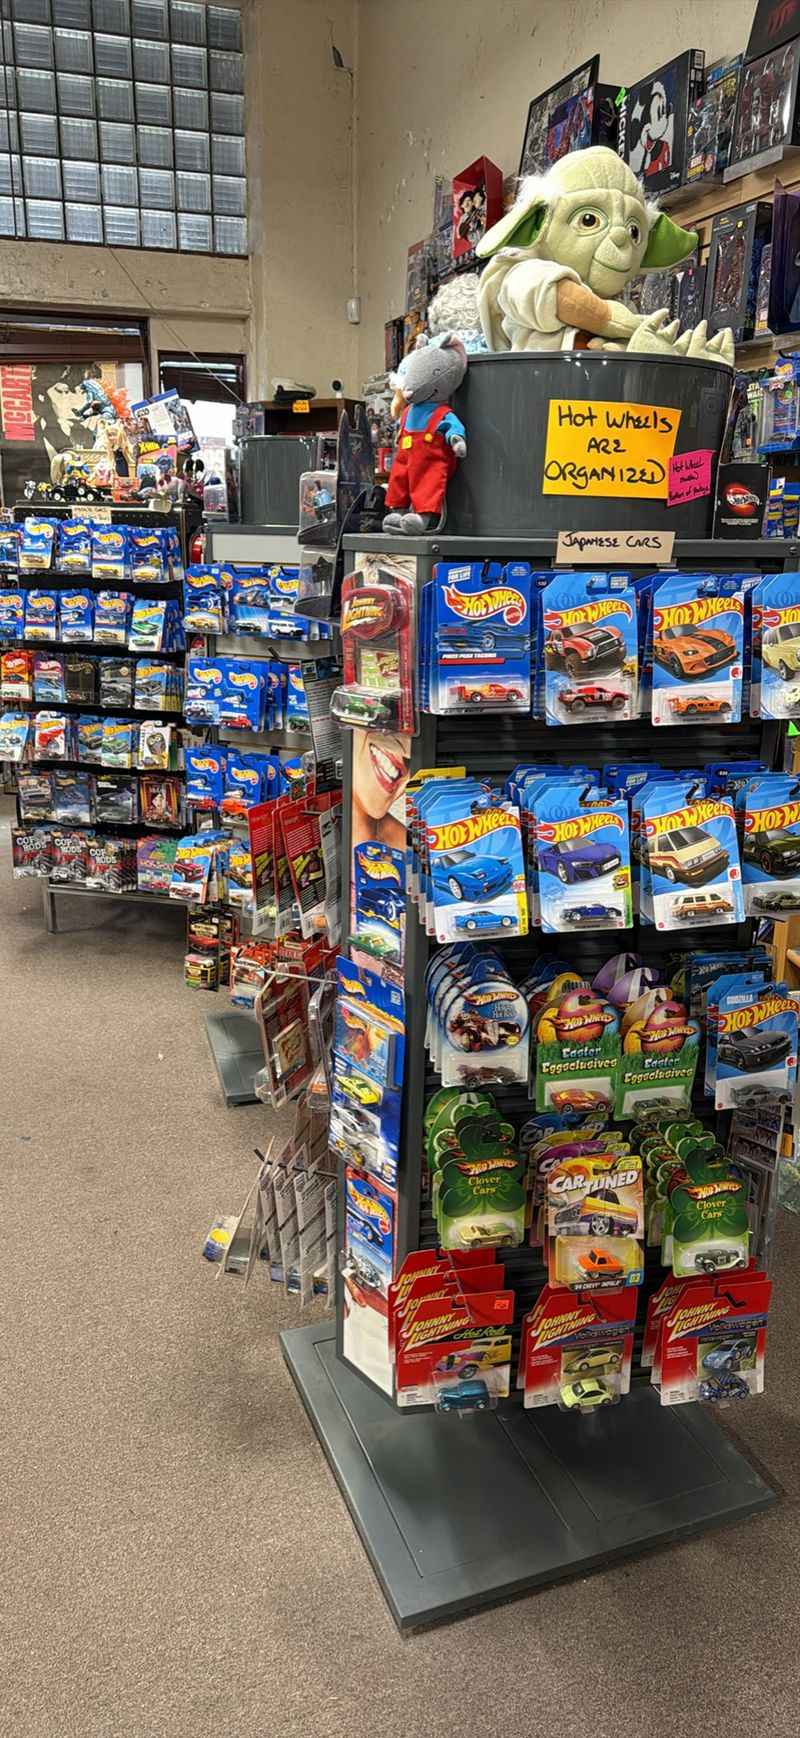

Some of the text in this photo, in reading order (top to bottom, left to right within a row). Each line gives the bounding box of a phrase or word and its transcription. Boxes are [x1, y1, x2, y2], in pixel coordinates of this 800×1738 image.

[558, 405, 597, 427] Hot
[587, 437, 627, 454] ARE
[544, 459, 666, 489] ORGANIZED
[562, 532, 662, 551] JAPANESE CARS
[463, 596, 487, 616] HOT
[561, 600, 628, 626] HOT WHEELS
[659, 597, 741, 631] HOT WHEELS
[436, 812, 517, 850] HOT WHEELS
[553, 814, 620, 842] HOT WHEELS
[654, 802, 731, 835] HOT WHEELS
[752, 810, 785, 833] HOT
[724, 999, 797, 1032] HOT WHEELS
[562, 1046, 601, 1059] Easter
[468, 1176, 501, 1186] Clover
[472, 1185, 497, 1196] Cars
[696, 1200, 726, 1210] Clover
[401, 1312, 457, 1339] JOHNNY
[530, 1308, 583, 1337] JOHNNY
[667, 1302, 720, 1328] JOHNNY
[404, 1316, 472, 1352] LIGHTNING
[532, 1313, 599, 1352] LIGHTNING
